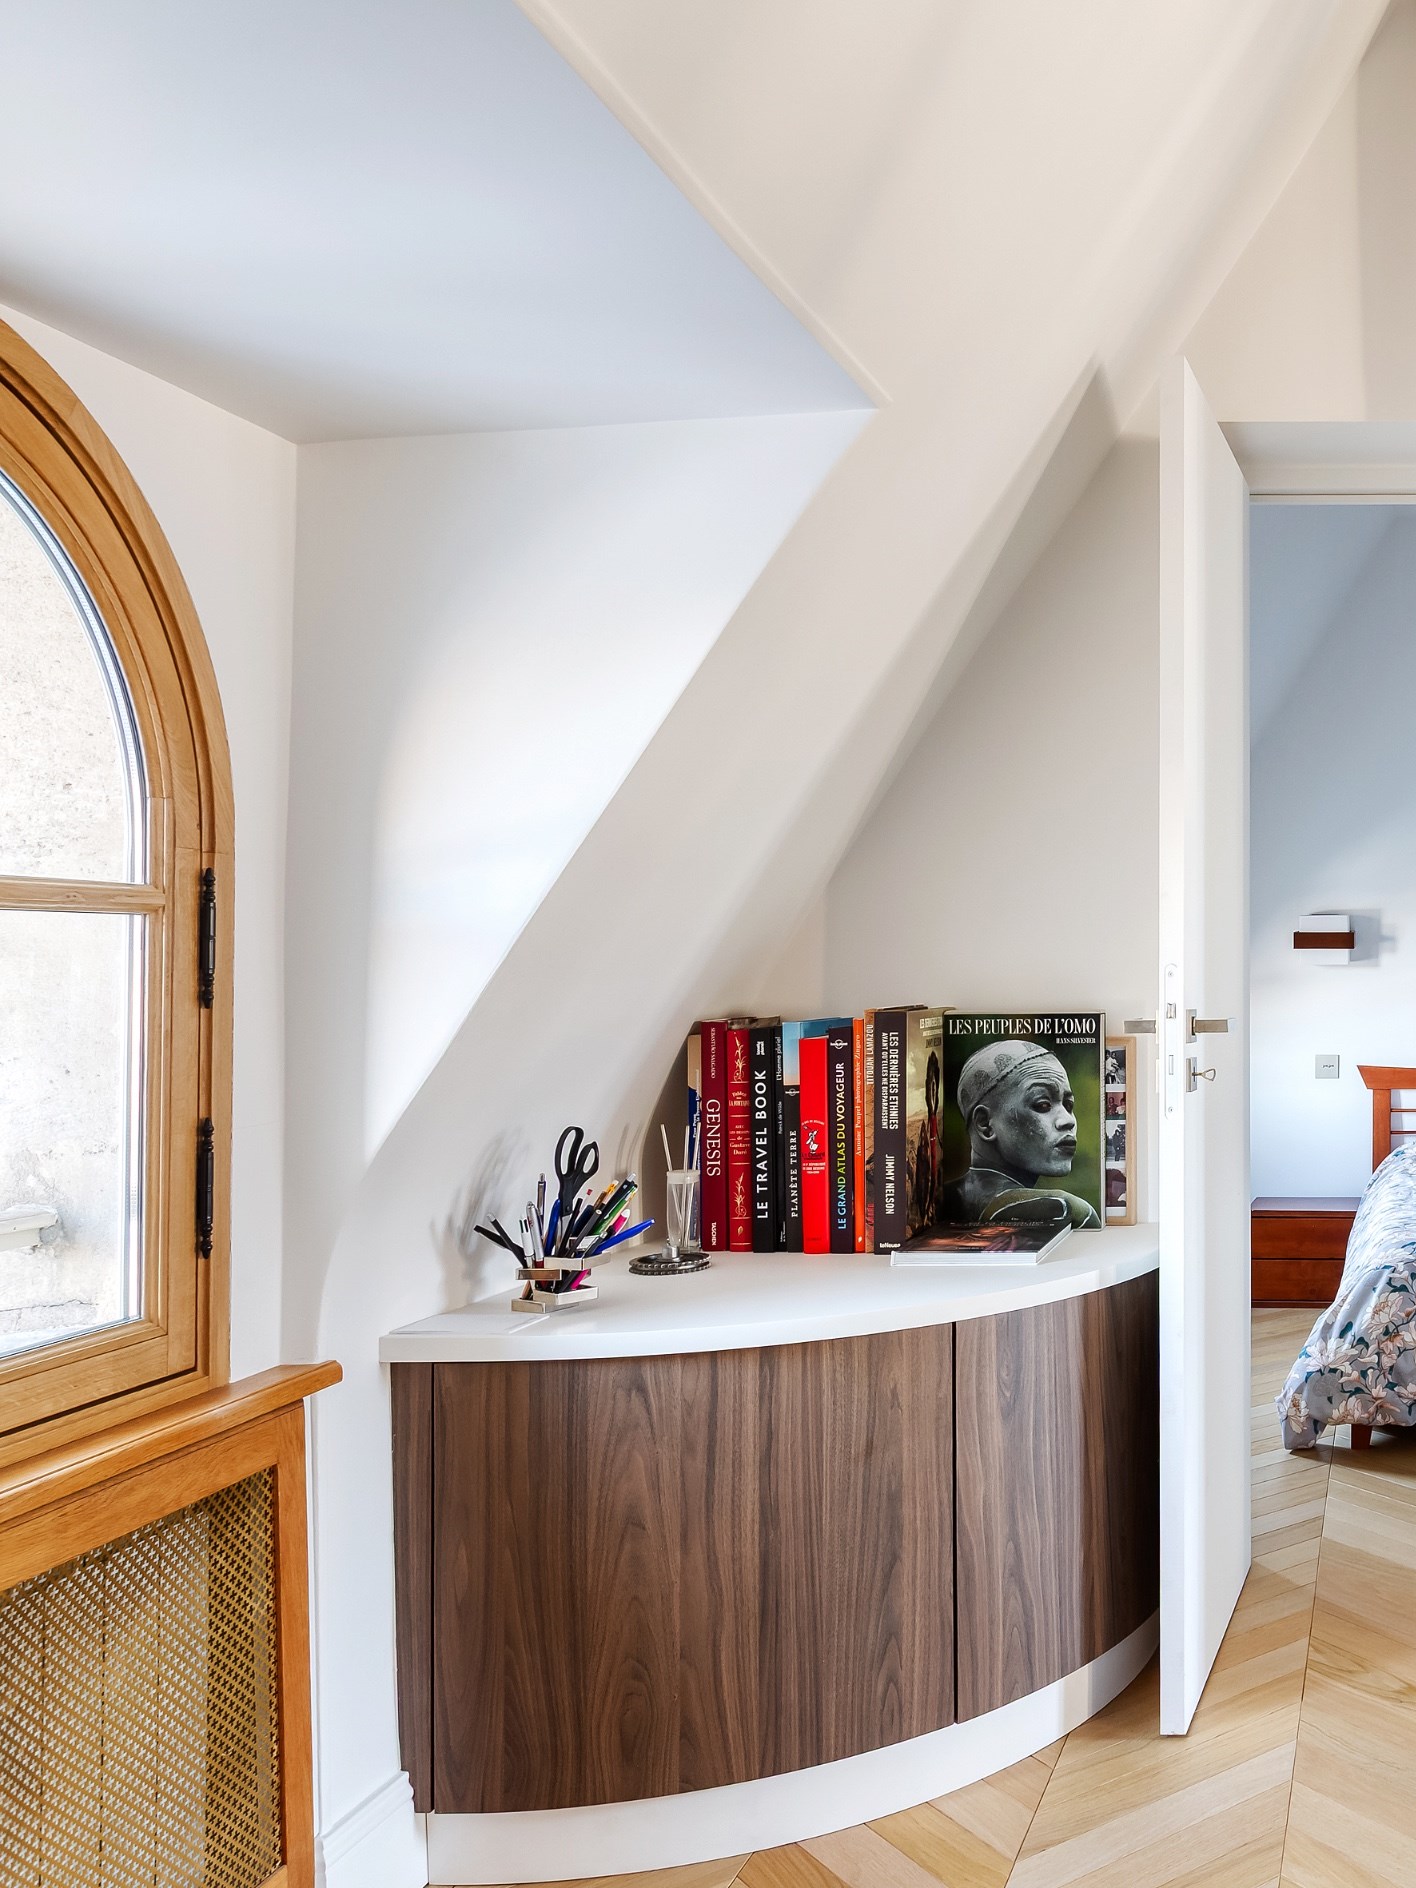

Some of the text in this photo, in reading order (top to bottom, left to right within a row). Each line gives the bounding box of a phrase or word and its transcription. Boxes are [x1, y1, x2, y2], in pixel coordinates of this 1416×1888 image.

[866, 1024, 874, 1085] TITOUAN LAMAZOU
[949, 1018, 1096, 1035] LES PEUPLES DE L'OMO
[882, 1076, 888, 1084] NE
[889, 1032, 900, 1129] LES DERNIÈRES ETHNIES
[706, 1100, 720, 1176] GENESIS
[754, 1070, 768, 1218] LE TRAVEL BOOK
[836, 1062, 846, 1229] LE GRAND ATLAS DU VOYAGEUR
[789, 1168, 798, 1217] PLANÈTE
[885, 1154, 895, 1214] JIMMY NELSON
